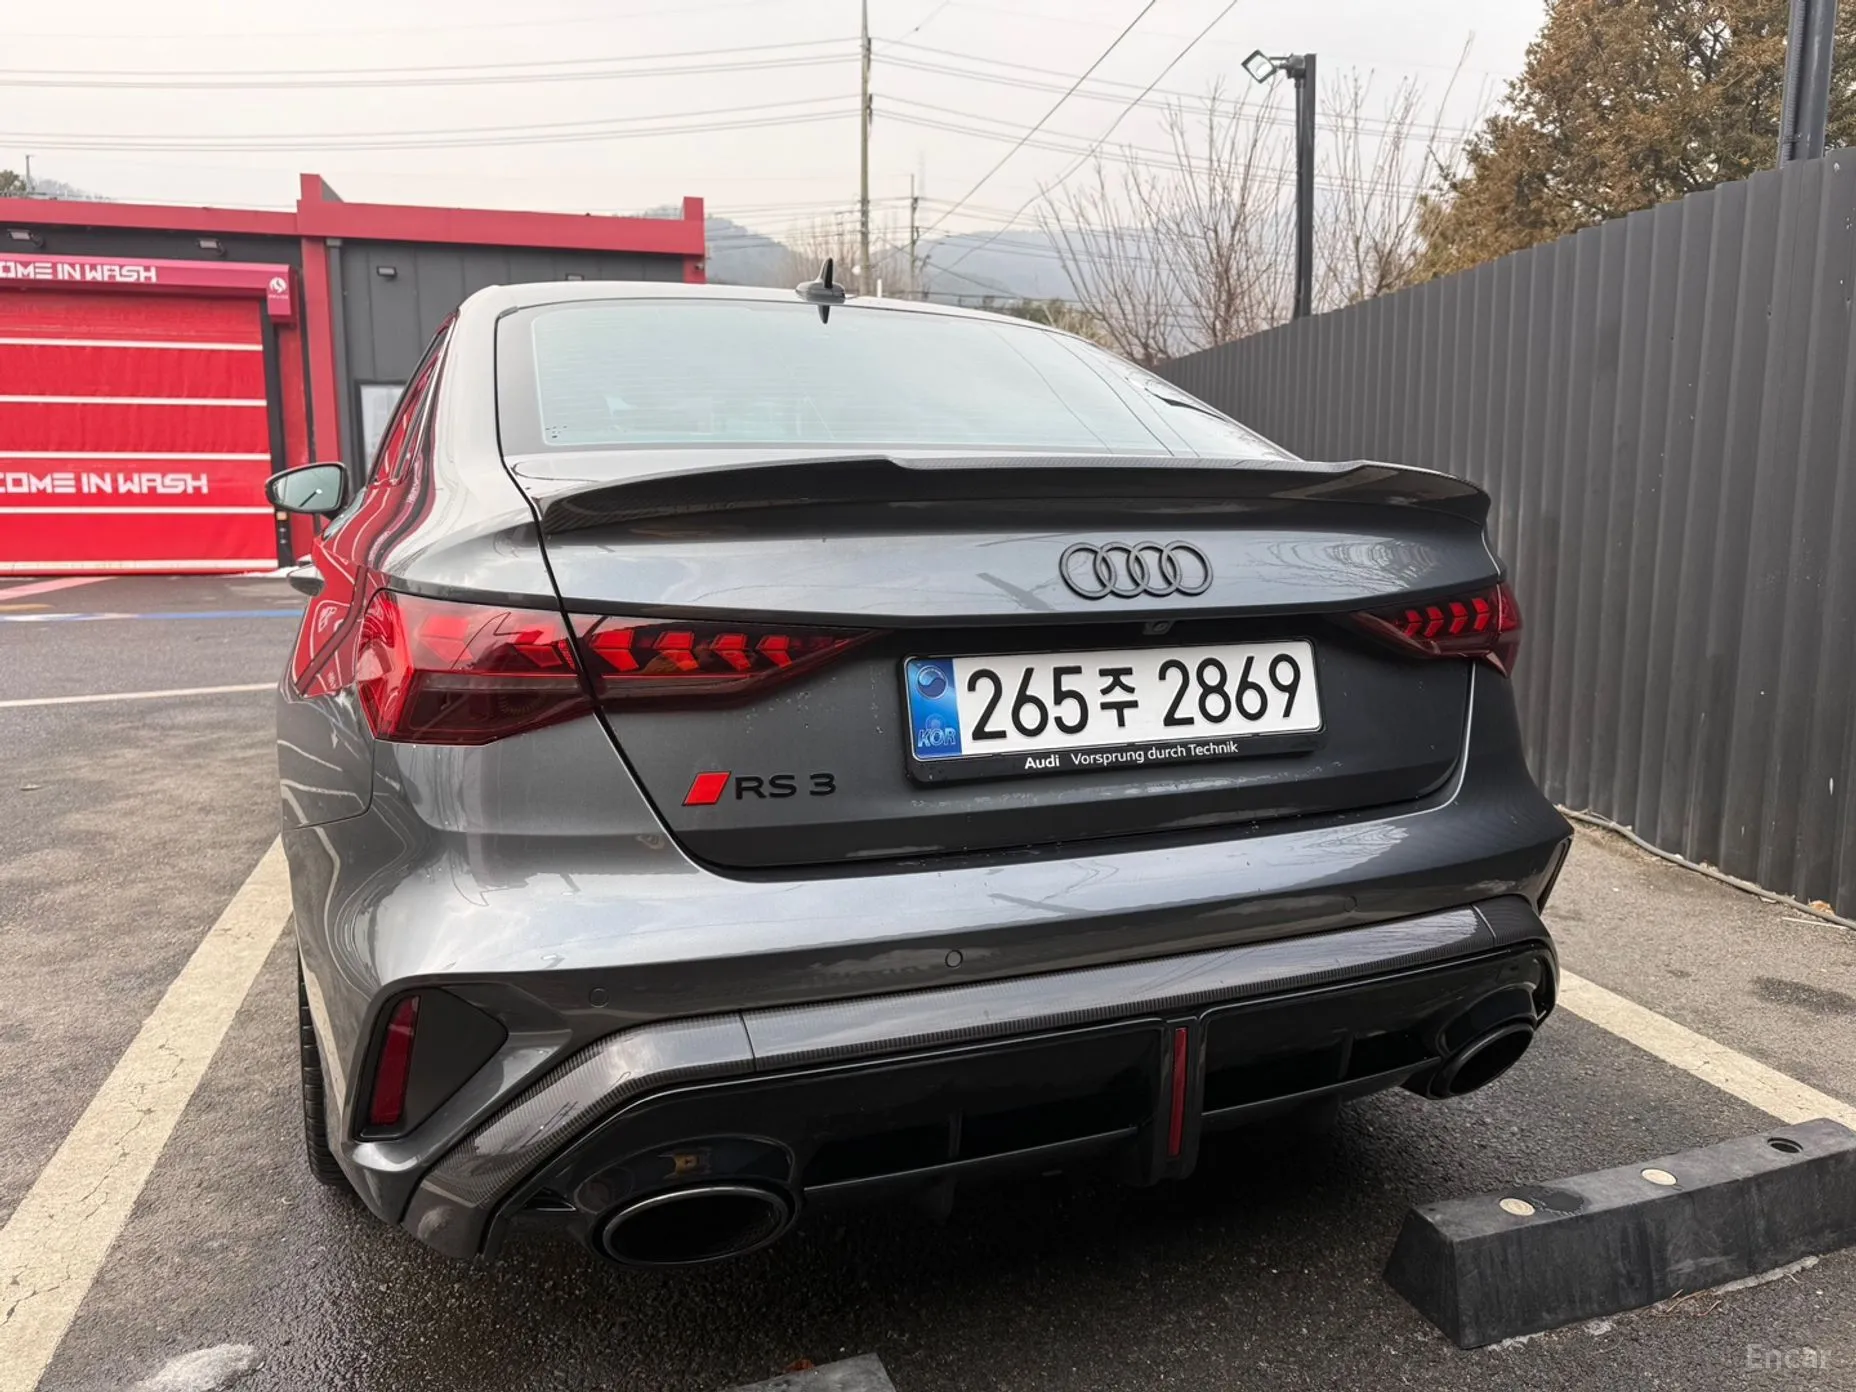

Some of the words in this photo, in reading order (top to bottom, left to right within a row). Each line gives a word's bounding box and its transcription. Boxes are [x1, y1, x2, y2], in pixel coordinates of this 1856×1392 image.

[57, 262, 81, 280] IN
[84, 264, 157, 283] WASH
[0, 471, 76, 494] OME
[81, 472, 113, 494] IN
[117, 472, 208, 494] WASH
[966, 665, 1139, 741] 265주
[1158, 653, 1301, 728] 2869
[917, 726, 957, 748] KOR
[1024, 754, 1061, 770] Audi
[1070, 749, 1145, 767] Vorsprung
[1147, 745, 1187, 760] durch
[1190, 741, 1239, 757] Technik
[734, 774, 798, 801] RS
[808, 772, 837, 797] 3
